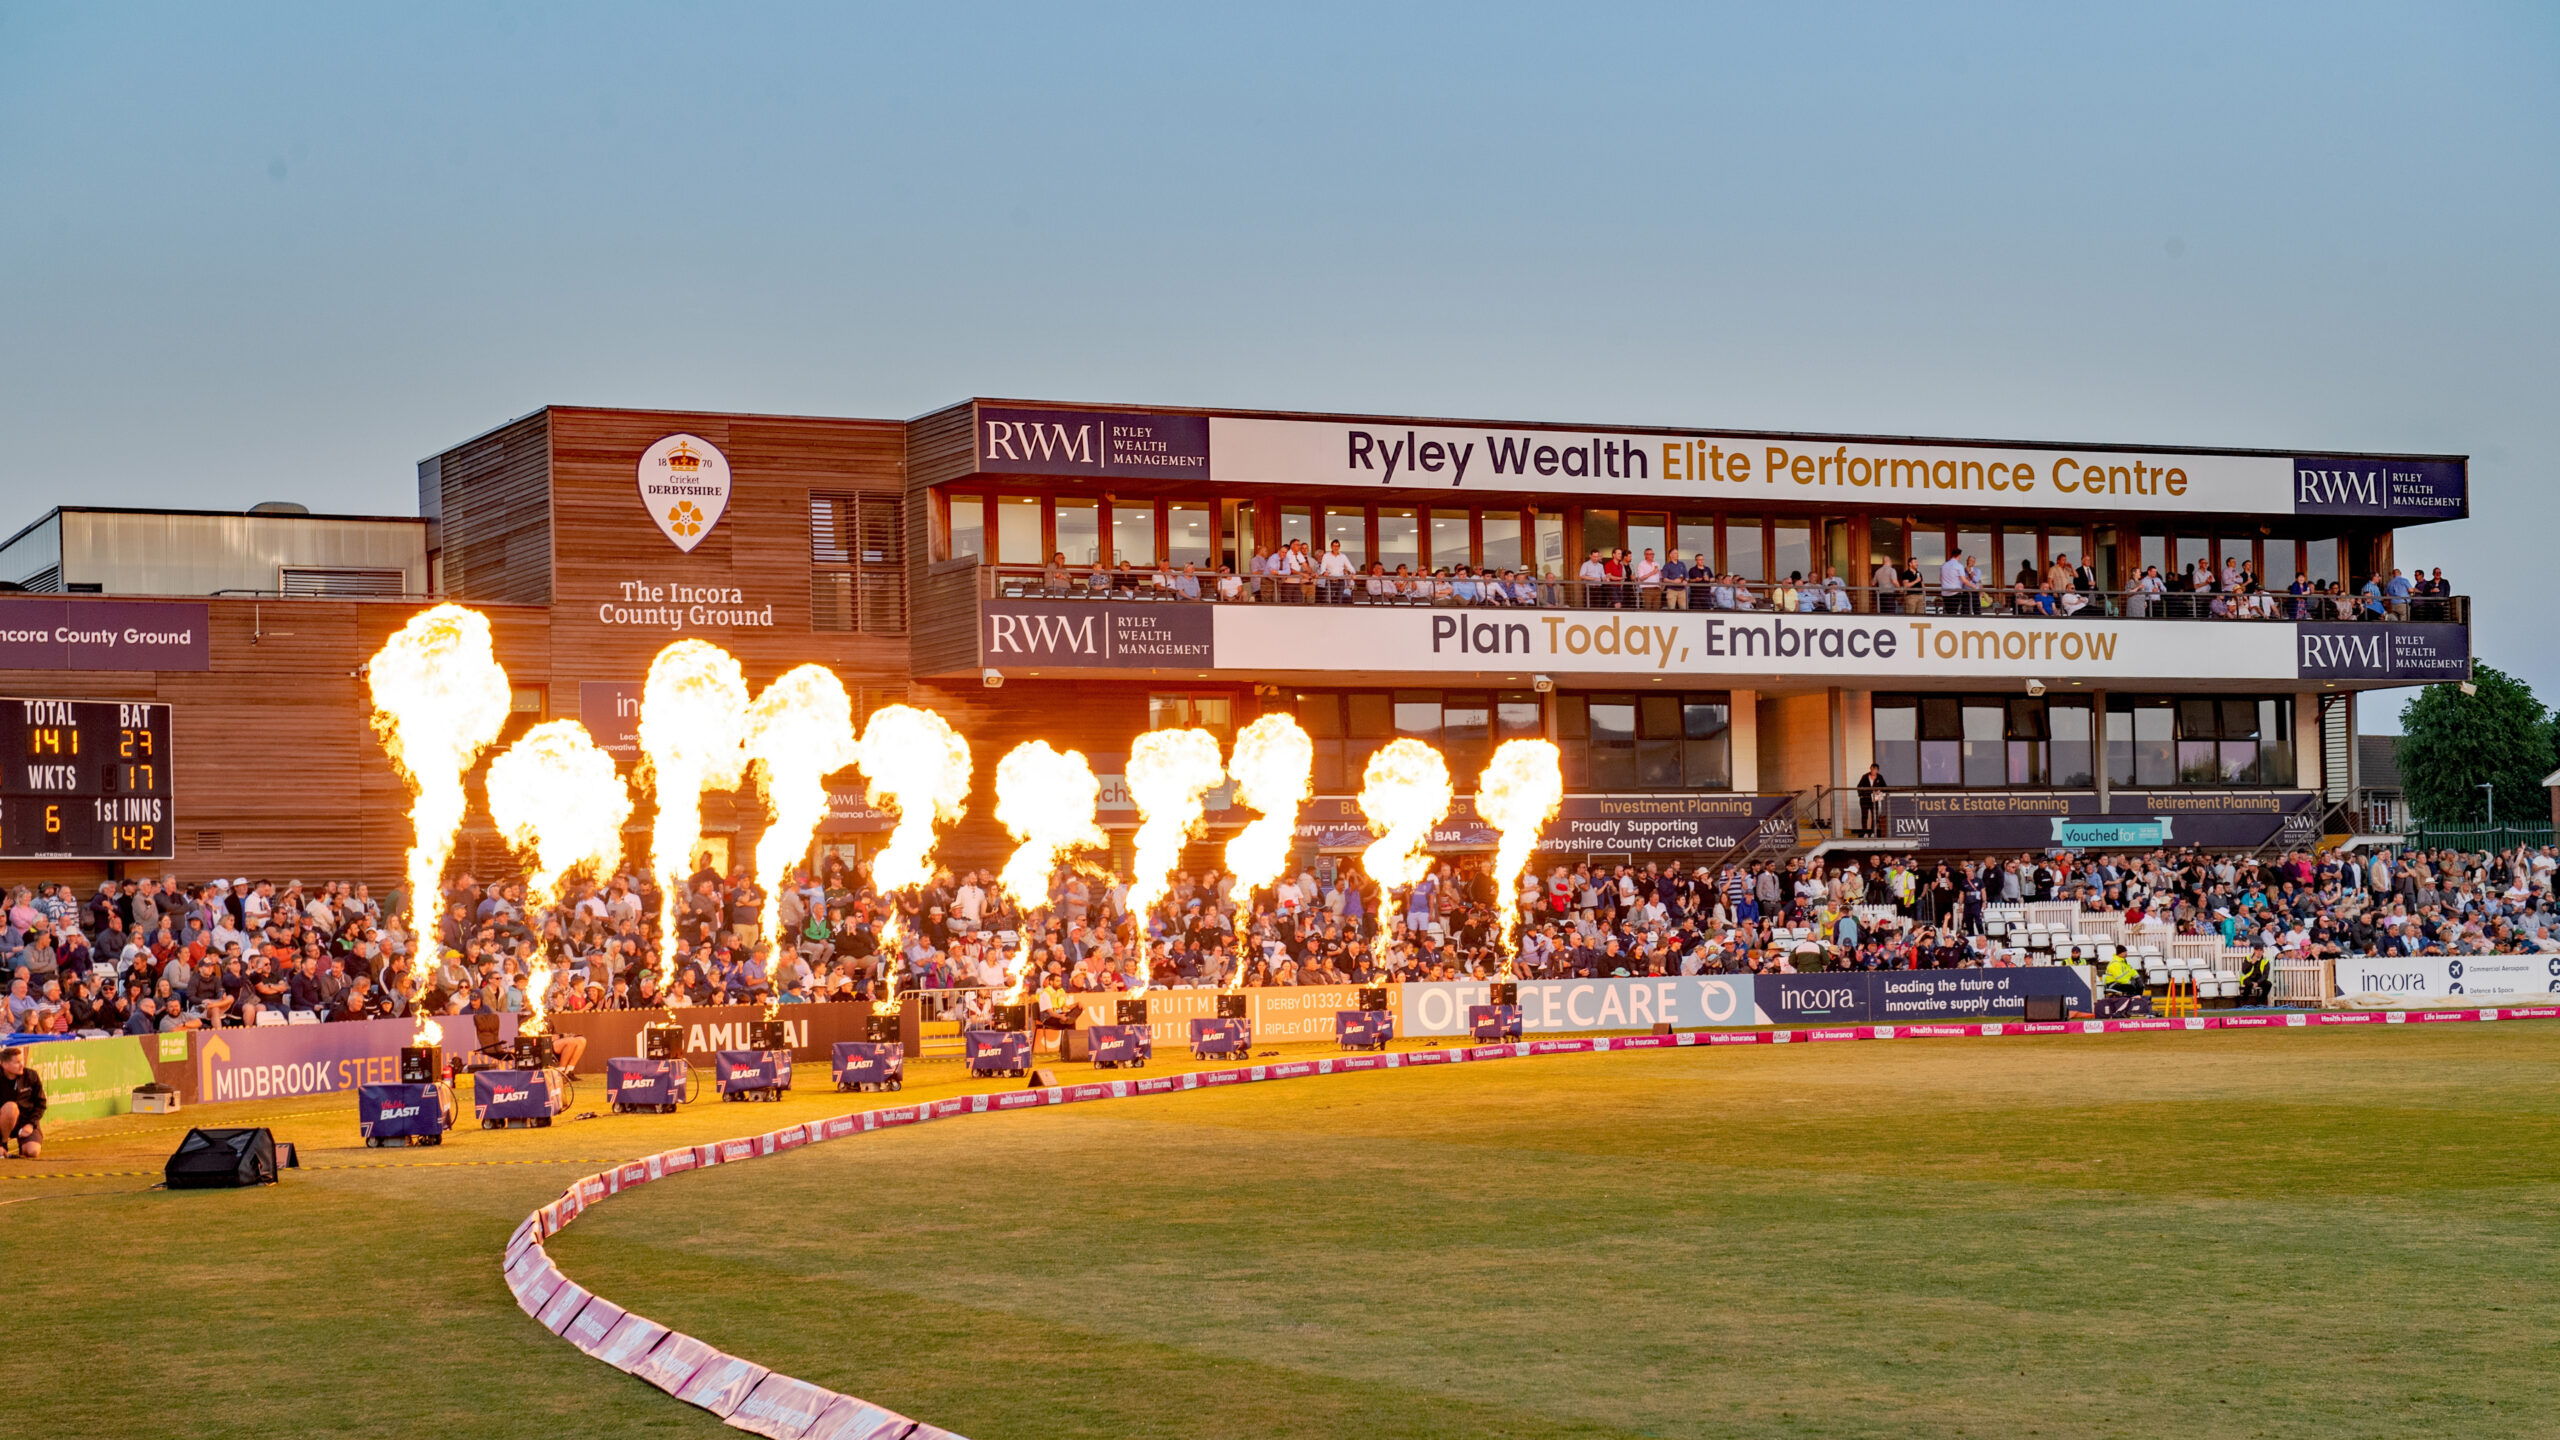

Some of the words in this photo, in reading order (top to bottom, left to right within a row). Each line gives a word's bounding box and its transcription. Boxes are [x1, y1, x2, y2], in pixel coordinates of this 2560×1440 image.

[1113, 426, 1153, 438] RYLEY
[985, 420, 1094, 463] RWM
[1113, 440, 1167, 452] WEALTH
[658, 458, 667, 467] 18
[702, 459, 713, 468] 70
[1113, 453, 1205, 467] MANAGEMENT
[1347, 431, 1474, 486] Ryley
[1487, 436, 1648, 479] Wealth
[1663, 439, 1751, 483] Elite
[1765, 446, 2035, 493] Performance
[2052, 457, 2188, 496] Centre
[669, 475, 700, 485] Cricket
[2392, 473, 2422, 483] RYLEY
[648, 485, 722, 497] DERBYSHIRE
[2298, 470, 2379, 505] RWM
[2393, 485, 2433, 494] WEALTH
[2393, 497, 2462, 507] MANAGEMENT
[620, 580, 664, 602] The
[670, 583, 743, 604] Incora
[599, 603, 683, 631] County
[689, 604, 775, 627] Ground
[1117, 616, 1157, 628] RYLEY
[55, 627, 118, 647] County
[124, 629, 191, 645] Ground
[989, 614, 1098, 654] RWM
[1118, 630, 1172, 641] WEALTH
[1432, 613, 1530, 655] Plan
[1541, 615, 1690, 669] Today,
[1706, 618, 1897, 660] Embrace
[1909, 622, 2118, 661] Tomorrow
[2395, 636, 2425, 645] RYLEY
[1118, 644, 1210, 655] MANAGEMENT
[2301, 634, 2382, 668] RWM
[2396, 647, 2436, 657] WEALTH
[2395, 658, 2464, 669] MANAGEMENT
[24, 701, 77, 726] TOTAL
[120, 704, 151, 728] BAT
[34, 729, 78, 754] 141
[120, 730, 153, 757] 23
[28, 764, 77, 790] WKTS
[129, 764, 153, 790] 17
[94, 797, 118, 822] 1st
[124, 798, 162, 823] INNS
[1600, 799, 1685, 814] Investment
[1688, 799, 1752, 816] Planning
[1950, 797, 1960, 812] &
[1963, 797, 2006, 812] Estate
[2009, 796, 2069, 814] Planning
[2147, 795, 2221, 810] Retirement
[2223, 795, 2280, 813] Planning
[45, 805, 60, 833] 6
[1896, 818, 1930, 833] RWM
[1571, 820, 1621, 836] Proudly
[1627, 820, 1698, 835] Supporting
[112, 824, 154, 850] 142
[1434, 831, 1461, 842] BAR
[1607, 837, 1654, 852] County
[1657, 836, 1702, 849] Cricket
[1706, 835, 1736, 848] Club
[2502, 965, 2529, 973] Aerospace
[1885, 980, 1935, 995] Leading
[1938, 979, 1957, 992] the
[1960, 978, 1994, 991] future
[1997, 976, 2011, 990] of
[2362, 969, 2426, 992] incora
[1781, 984, 1854, 1011] incora
[2498, 987, 2514, 995] Space
[1267, 996, 1301, 1010] DERBY
[1303, 993, 1342, 1009] 01332
[1418, 982, 1679, 1031] OFFCECARE
[1885, 998, 1947, 1012] innovative
[1950, 997, 1991, 1013] supply
[1993, 995, 2024, 1008] chain
[2321, 1015, 2341, 1023] Health
[2342, 1014, 2370, 1022] insurance
[2512, 1009, 2530, 1017] Health
[2530, 1008, 2557, 1016] insurance
[1265, 1021, 1301, 1035] RIPLEY
[1303, 1018, 1335, 1033] 0177
[1910, 1026, 1930, 1034] Health
[1931, 1026, 1965, 1034] insurance
[2036, 1023, 2064, 1031] insurance
[2119, 1021, 2139, 1029] Health
[2140, 1021, 2170, 1029] insurance
[683, 1020, 808, 1053] AMUAI
[1624, 1038, 1633, 1046] Life
[1634, 1038, 1659, 1046] insurance
[1710, 1034, 1729, 1042] Health
[1730, 1033, 1756, 1042] insurance
[1812, 1031, 1823, 1039] Life
[1825, 1031, 1853, 1039] insurance
[60, 1055, 75, 1079] visit
[846, 1059, 873, 1070] BLAST!
[216, 1060, 331, 1100] MIDBROOK
[730, 1069, 760, 1080] BLAST!
[622, 1078, 655, 1089] BLAST!
[492, 1091, 529, 1104] BLAST!
[380, 1106, 420, 1120] BLAST!
